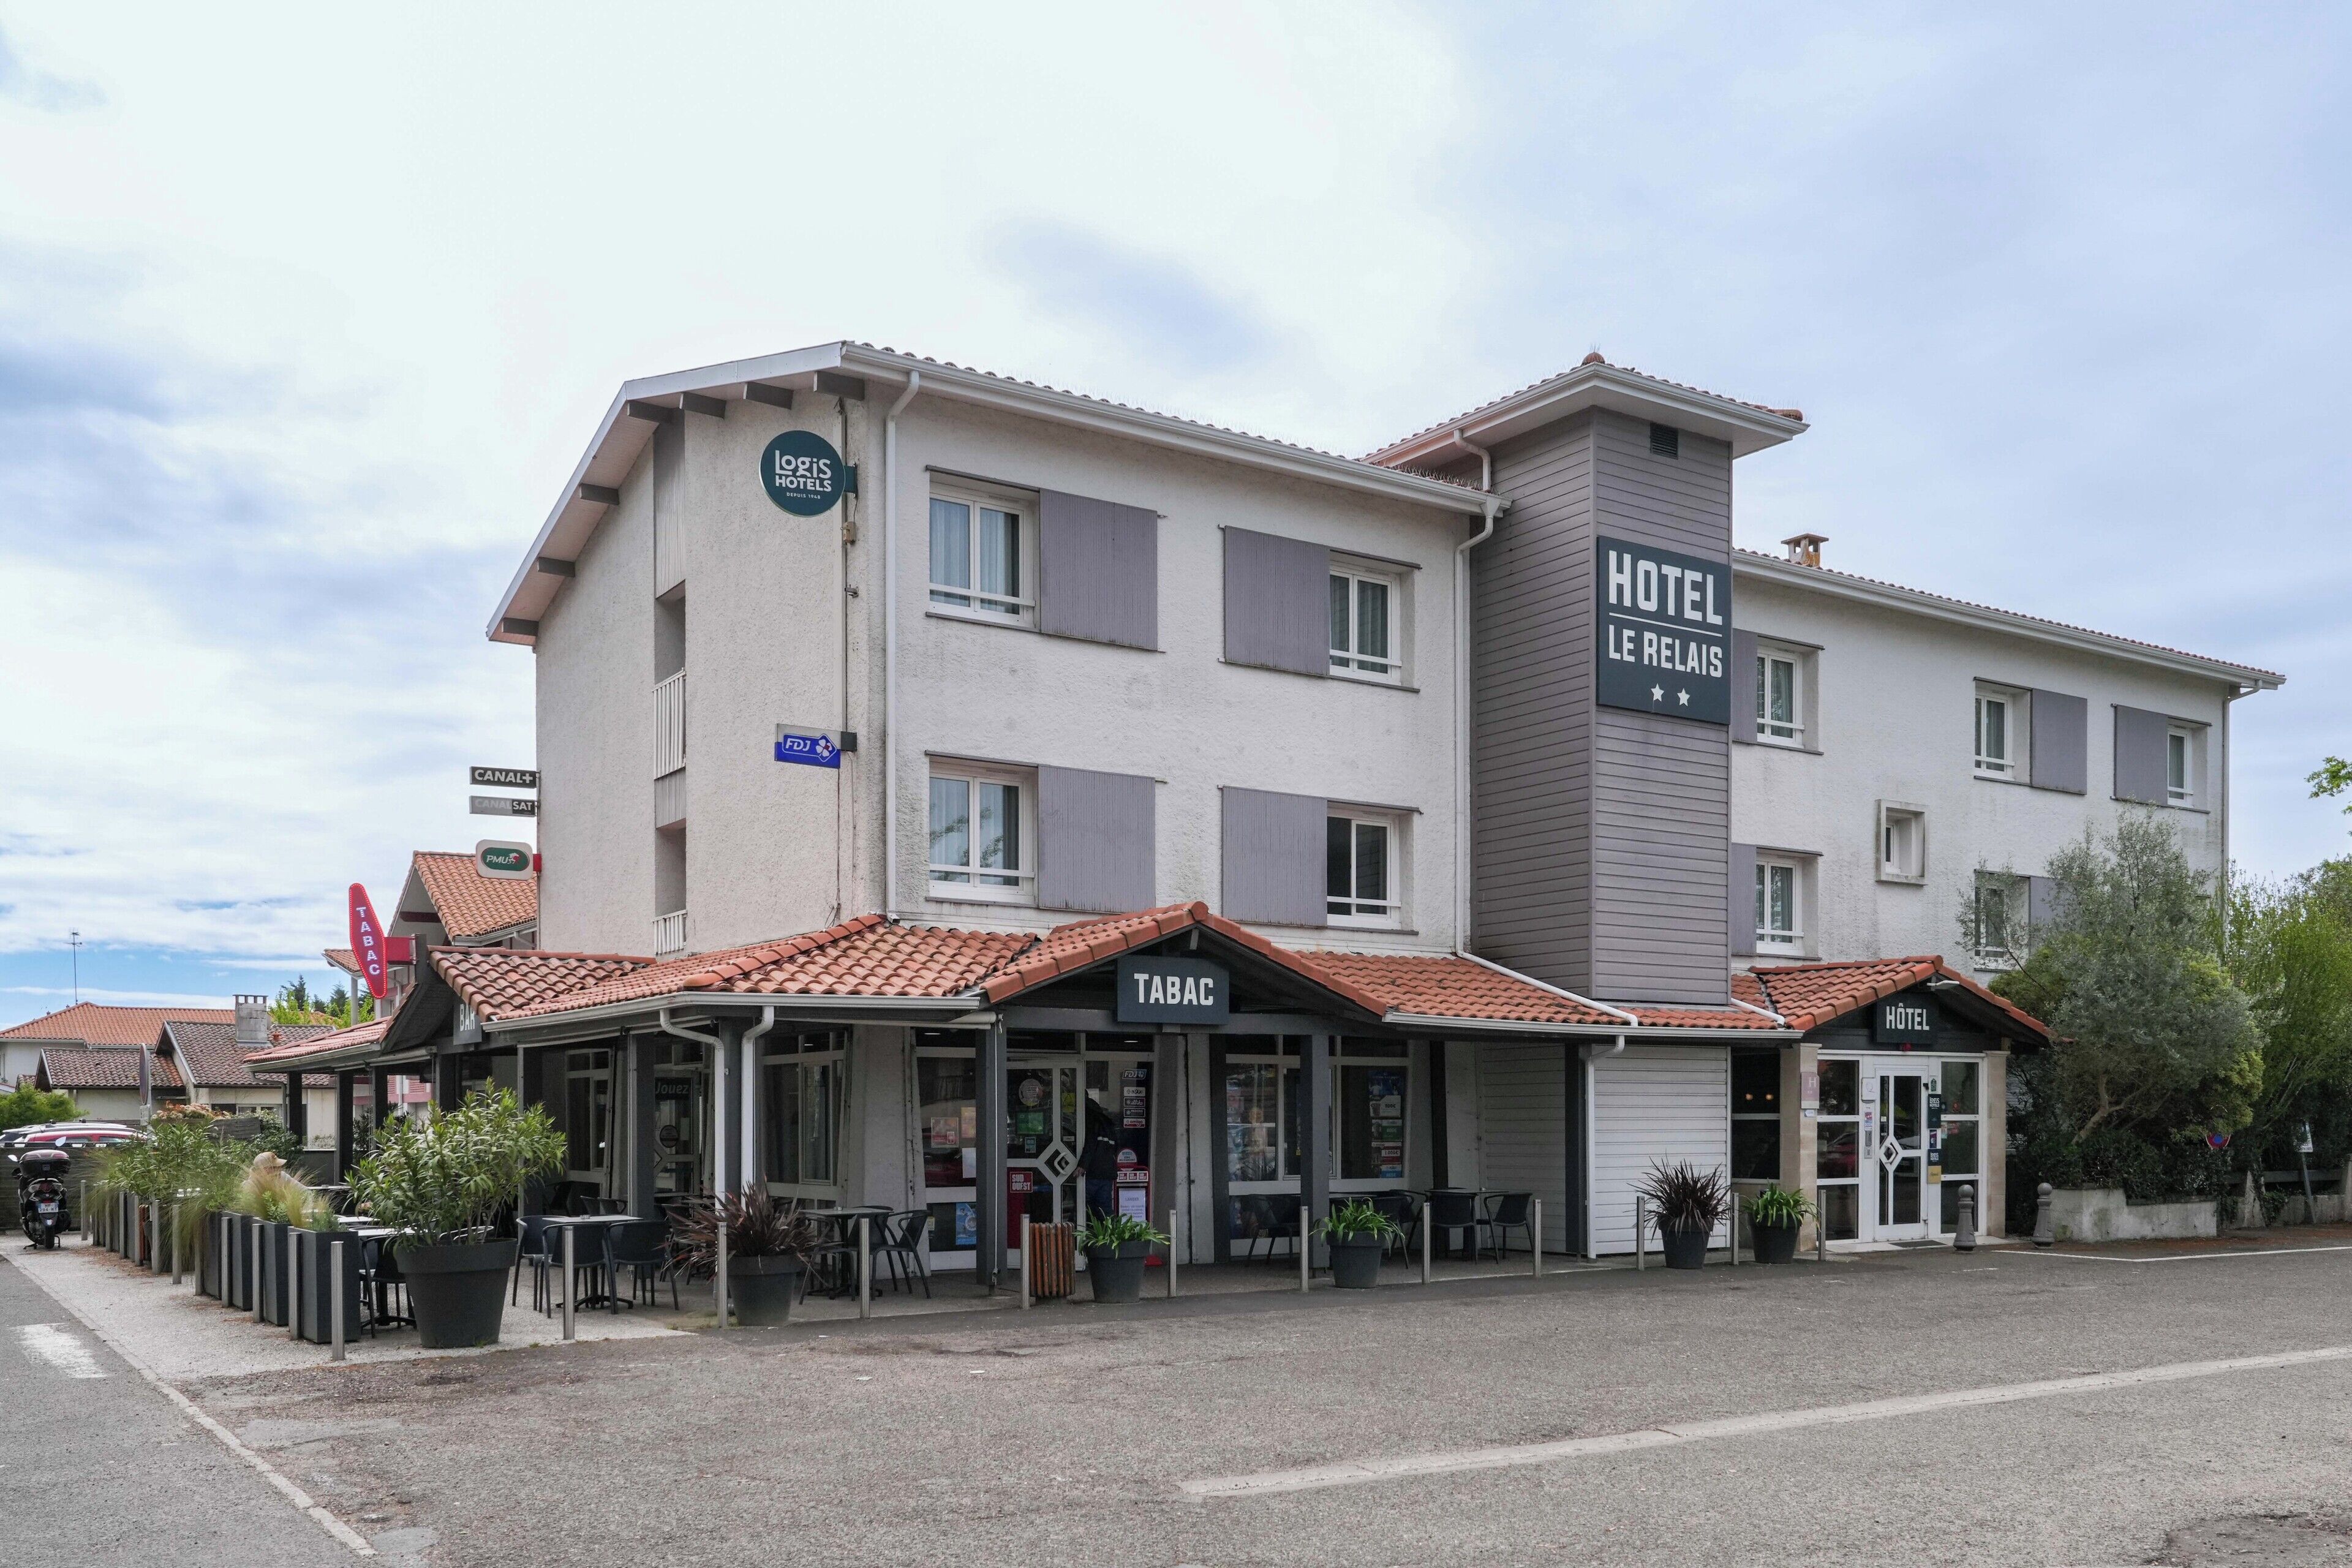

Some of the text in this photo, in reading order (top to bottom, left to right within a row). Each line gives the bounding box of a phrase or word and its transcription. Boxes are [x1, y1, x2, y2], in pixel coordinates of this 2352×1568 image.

[775, 475, 832, 492] HOTELS
[1608, 549, 1723, 625] HOTEL
[1608, 624, 1722, 678] LE RELAIS
[785, 737, 811, 752] FDJ
[474, 769, 533, 783] CANAL+
[486, 855, 508, 864] PMU
[356, 907, 380, 975] TABAC
[1134, 973, 1213, 1006] TABAC
[1886, 1003, 1930, 1030] HÔTEL
[655, 1082, 689, 1094] Jouez
[1809, 1077, 1817, 1087] H
[1012, 1182, 1031, 1191] OUEST
